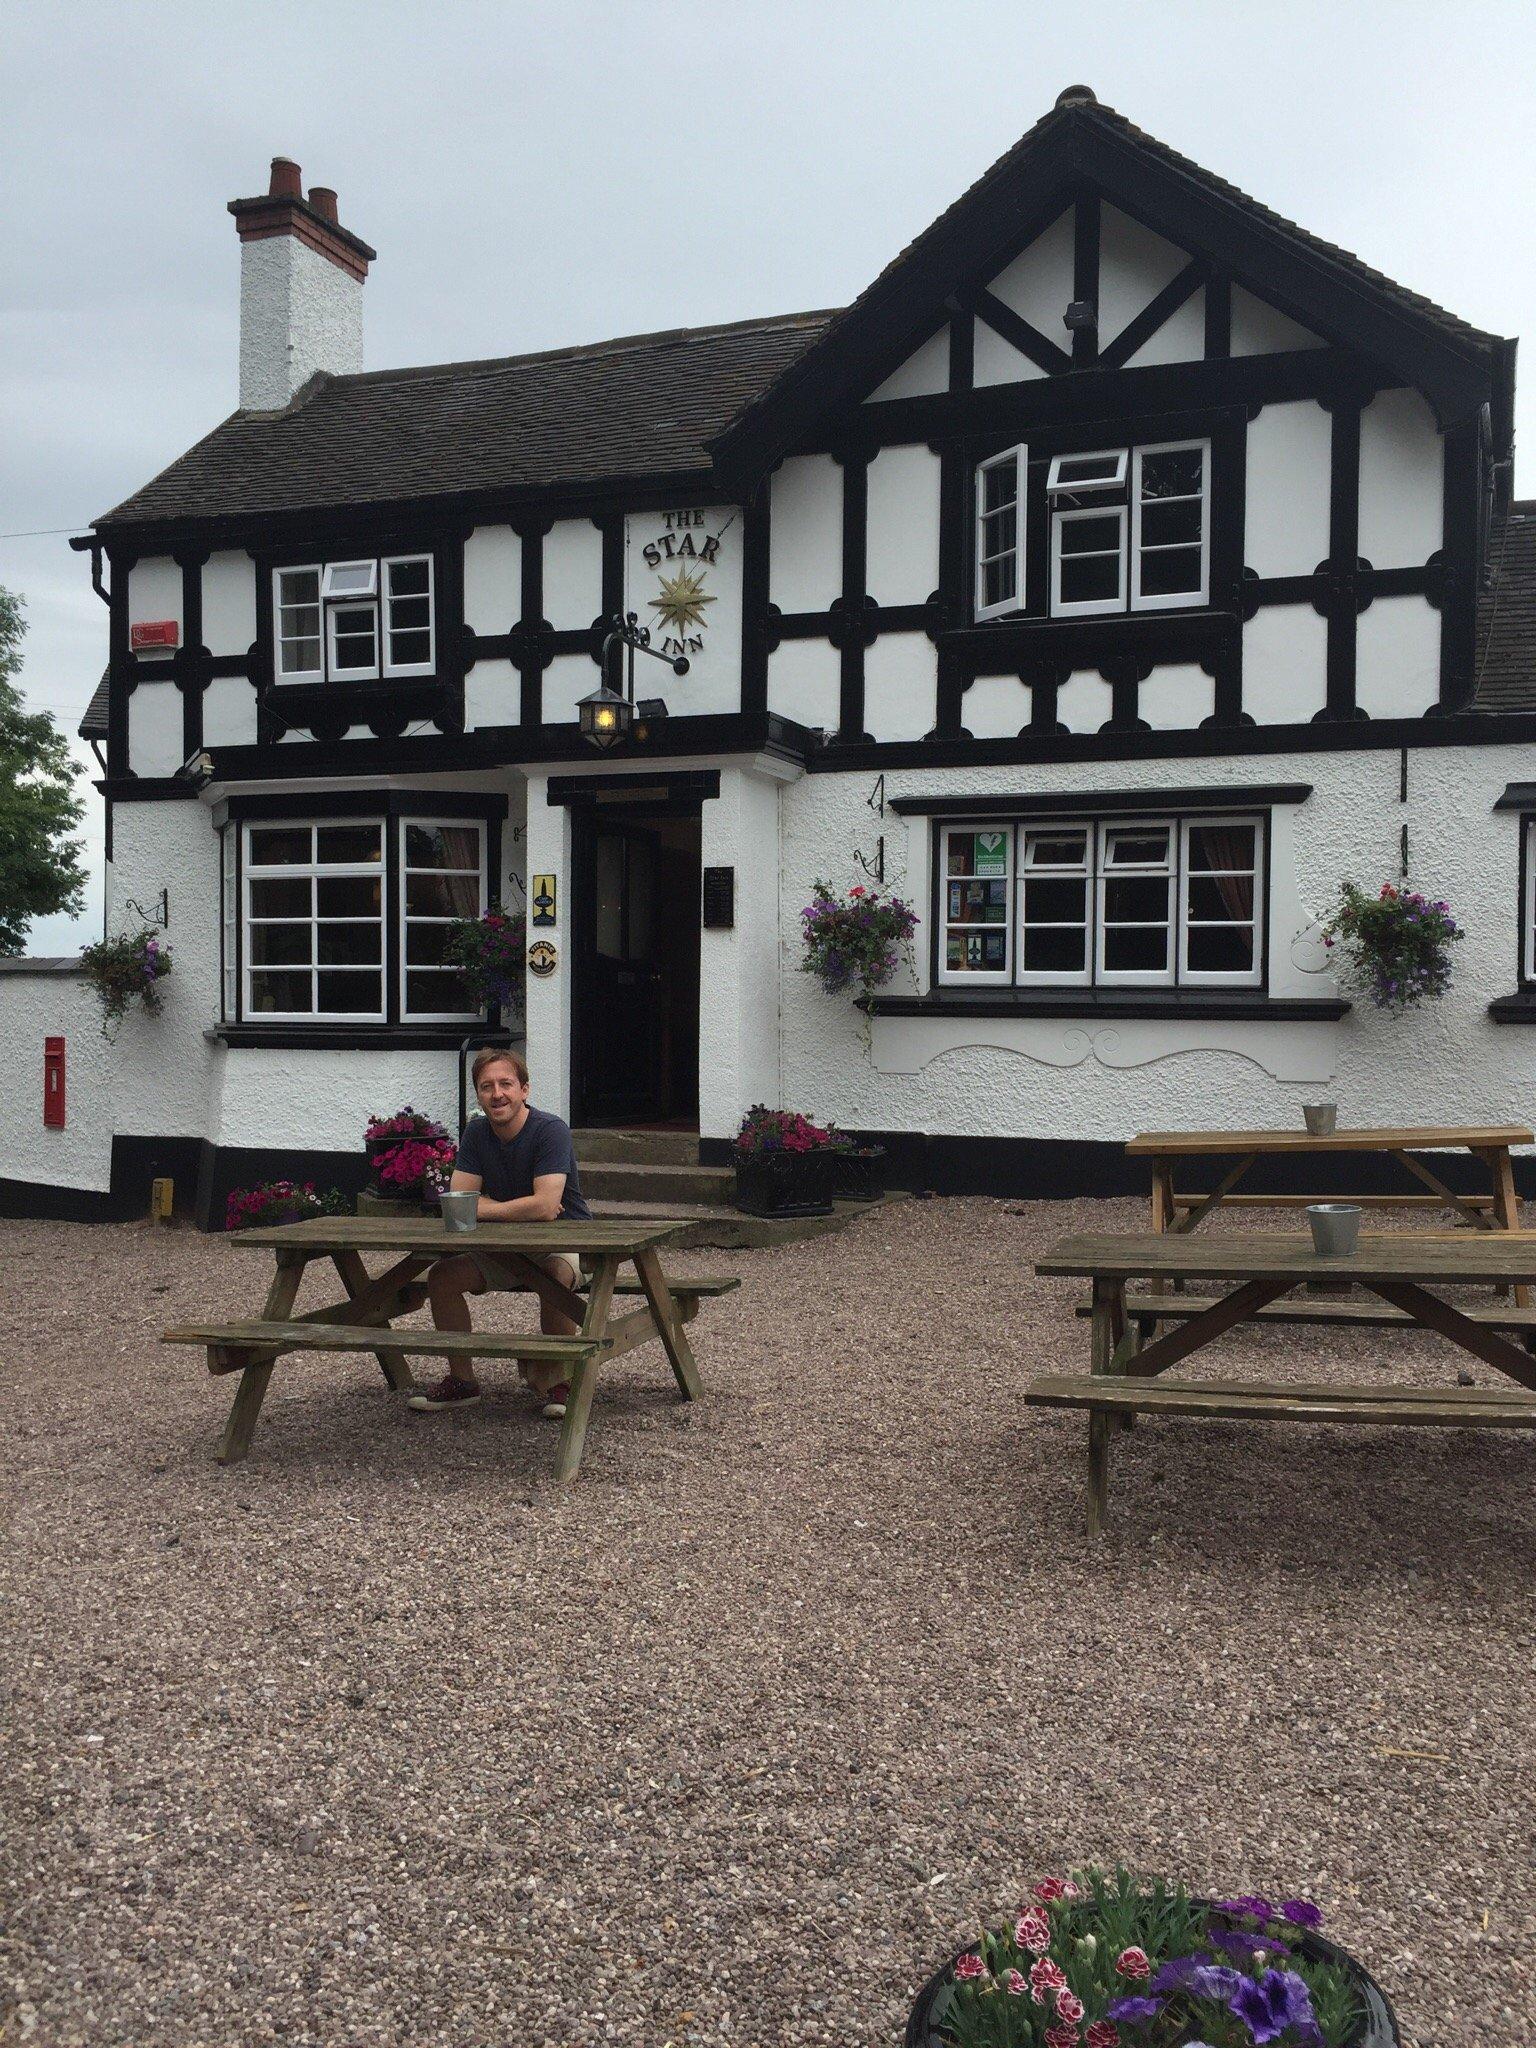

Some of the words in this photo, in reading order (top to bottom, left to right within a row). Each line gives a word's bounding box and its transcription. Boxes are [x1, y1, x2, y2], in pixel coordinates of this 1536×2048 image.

[663, 510, 704, 528] THE
[643, 533, 720, 567] STAR
[661, 634, 704, 654] INN
[530, 941, 555, 954] TITANIC
